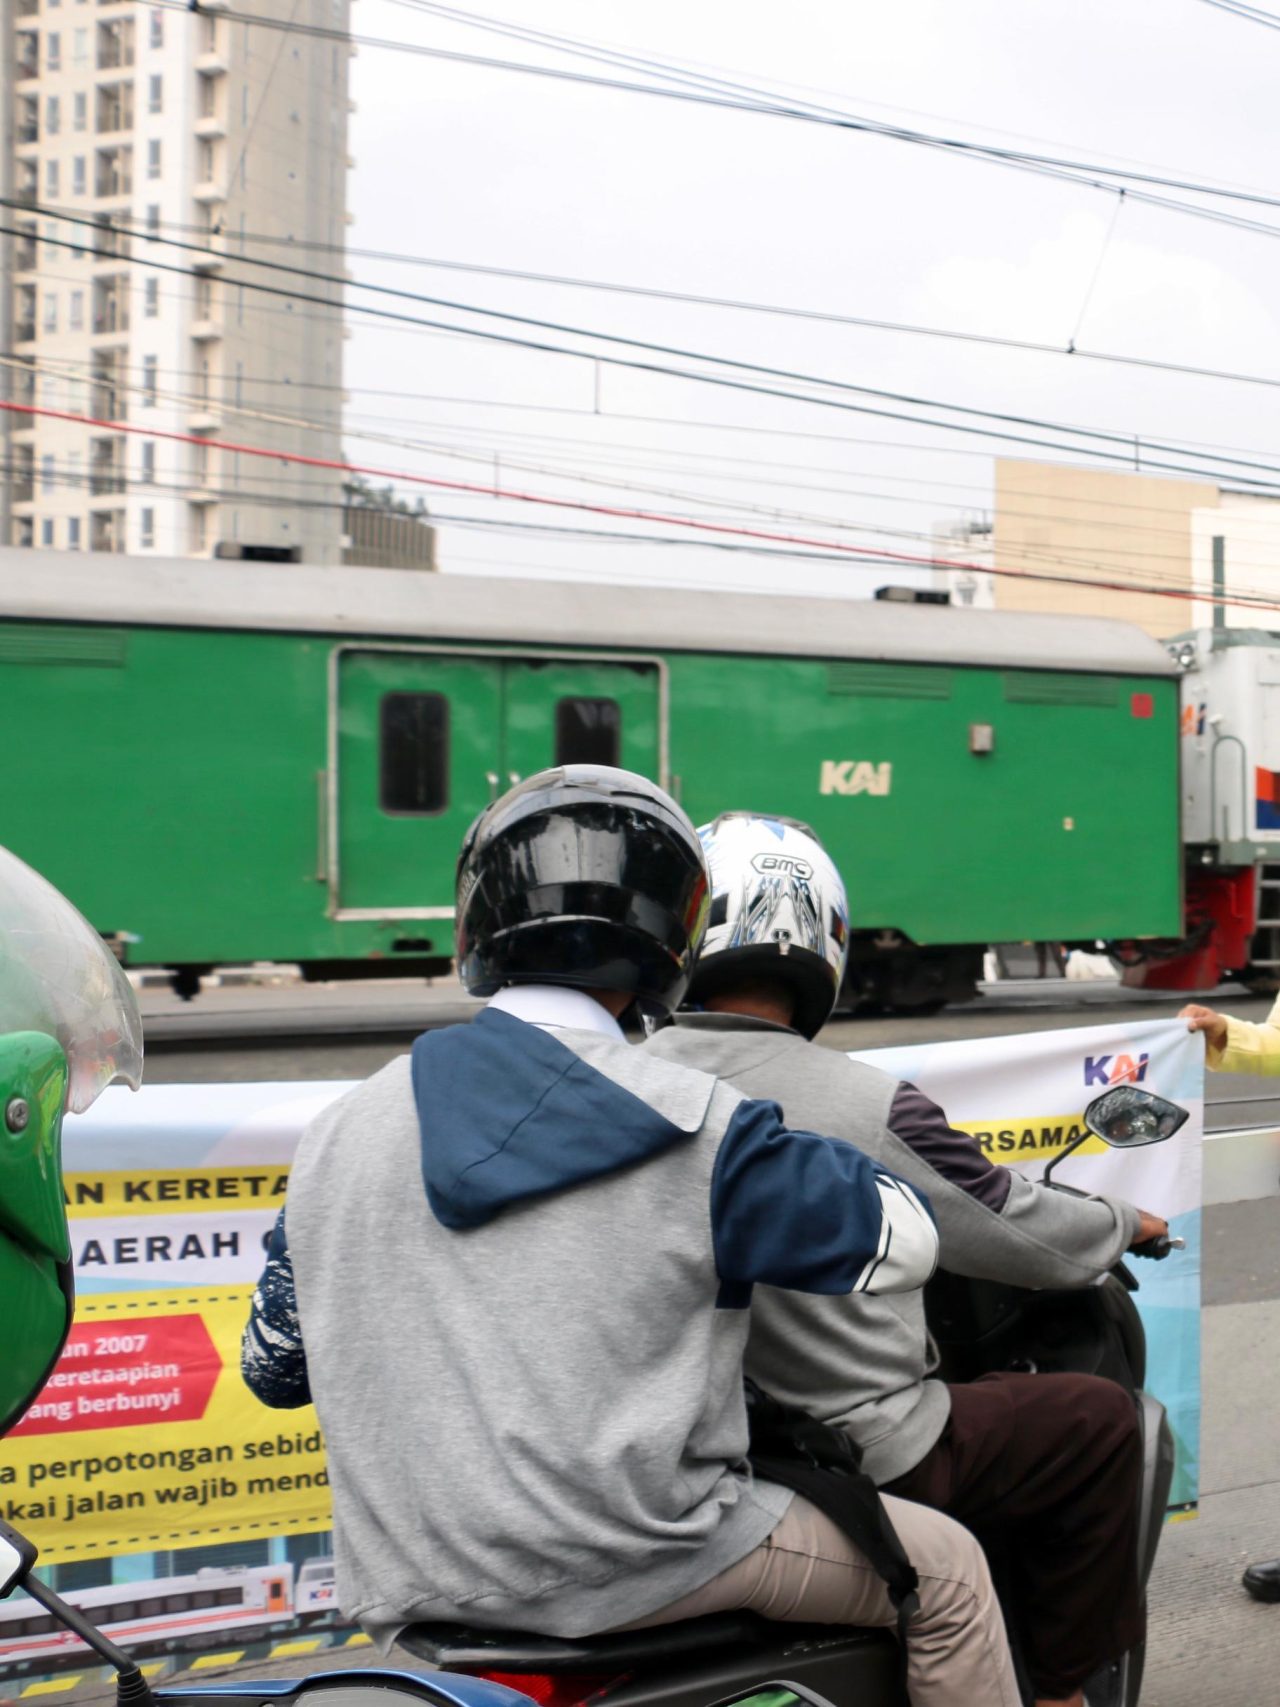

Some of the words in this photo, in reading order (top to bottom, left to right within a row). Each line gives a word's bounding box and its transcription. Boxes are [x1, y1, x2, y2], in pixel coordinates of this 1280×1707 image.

[820, 760, 891, 795] KAI
[1084, 1053, 1149, 1087] KAI
[124, 1175, 288, 1202] KERETA
[78, 1231, 239, 1267] AERAH
[95, 1334, 148, 1356] 2007
[77, 1388, 181, 1414] berbunyi
[29, 1443, 233, 1488] perpotongan
[243, 1431, 326, 1459] sebid
[64, 1490, 145, 1521] jalan
[154, 1477, 237, 1506] wajib
